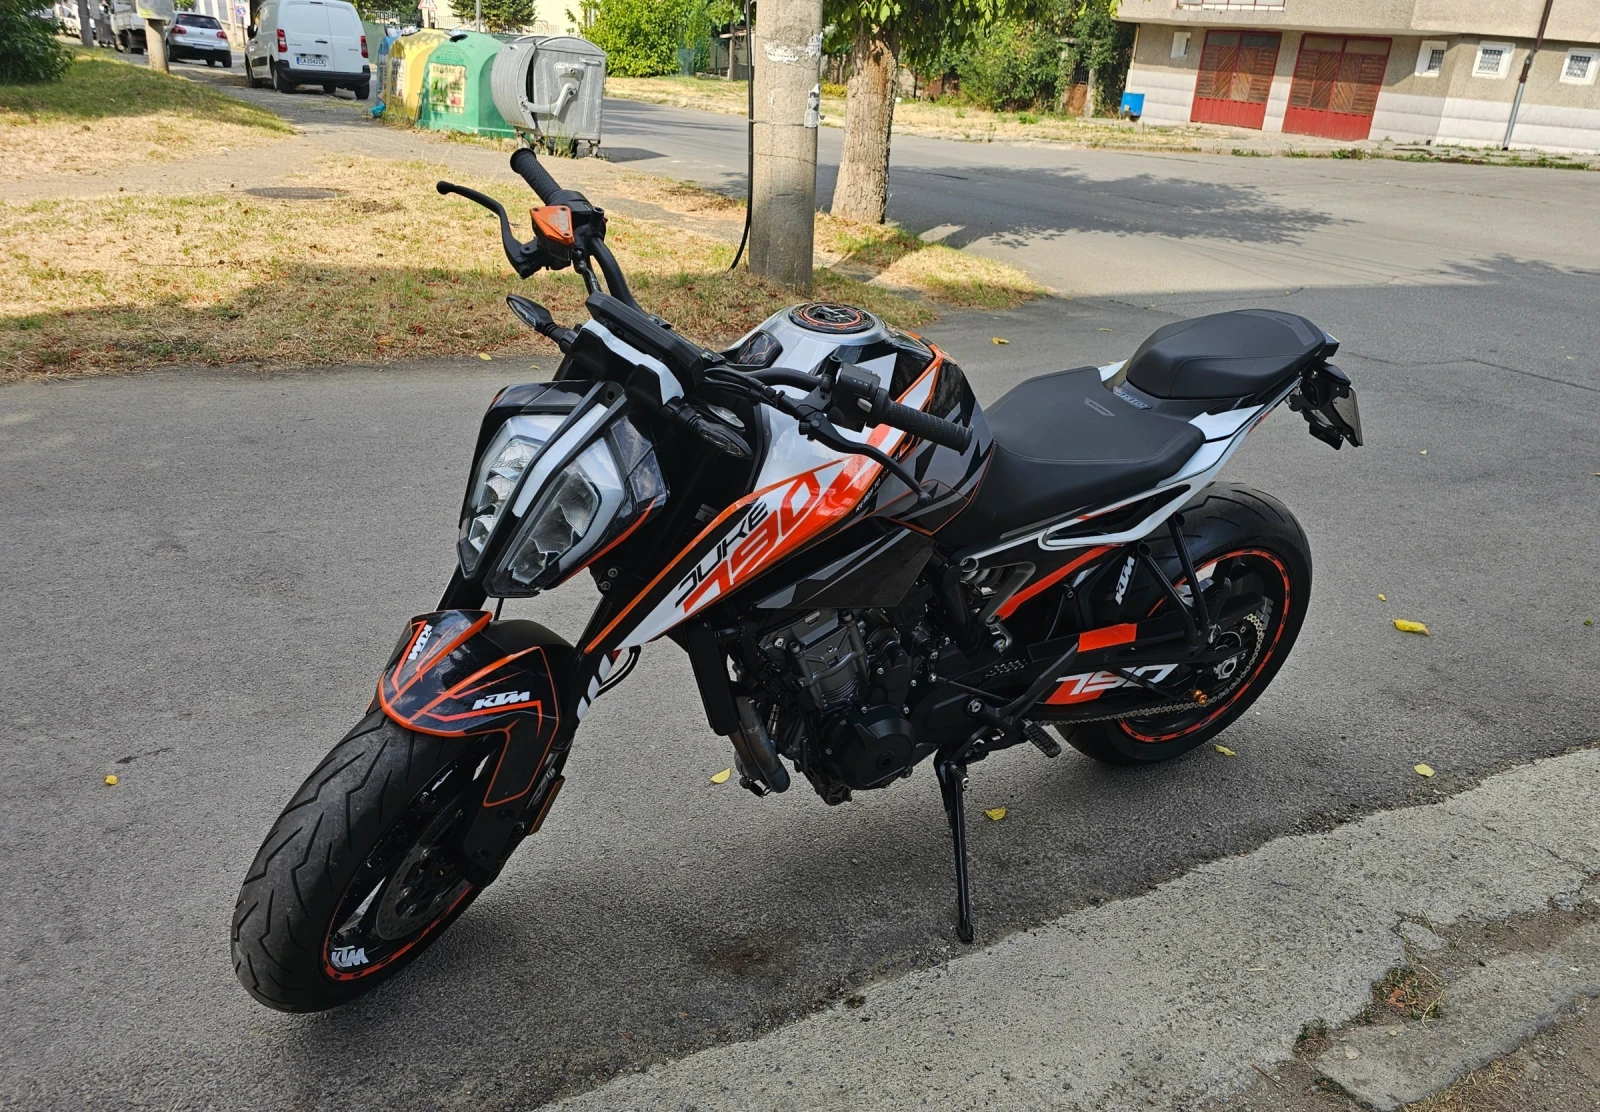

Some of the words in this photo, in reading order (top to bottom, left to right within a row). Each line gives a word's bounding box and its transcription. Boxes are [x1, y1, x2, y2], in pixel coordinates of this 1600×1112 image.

[675, 500, 769, 609] DUKE
[683, 472, 822, 614] 790
[1115, 555, 1135, 606] KTM
[407, 624, 433, 661] KTM
[471, 691, 531, 711] KTM
[331, 944, 370, 968] KTM
